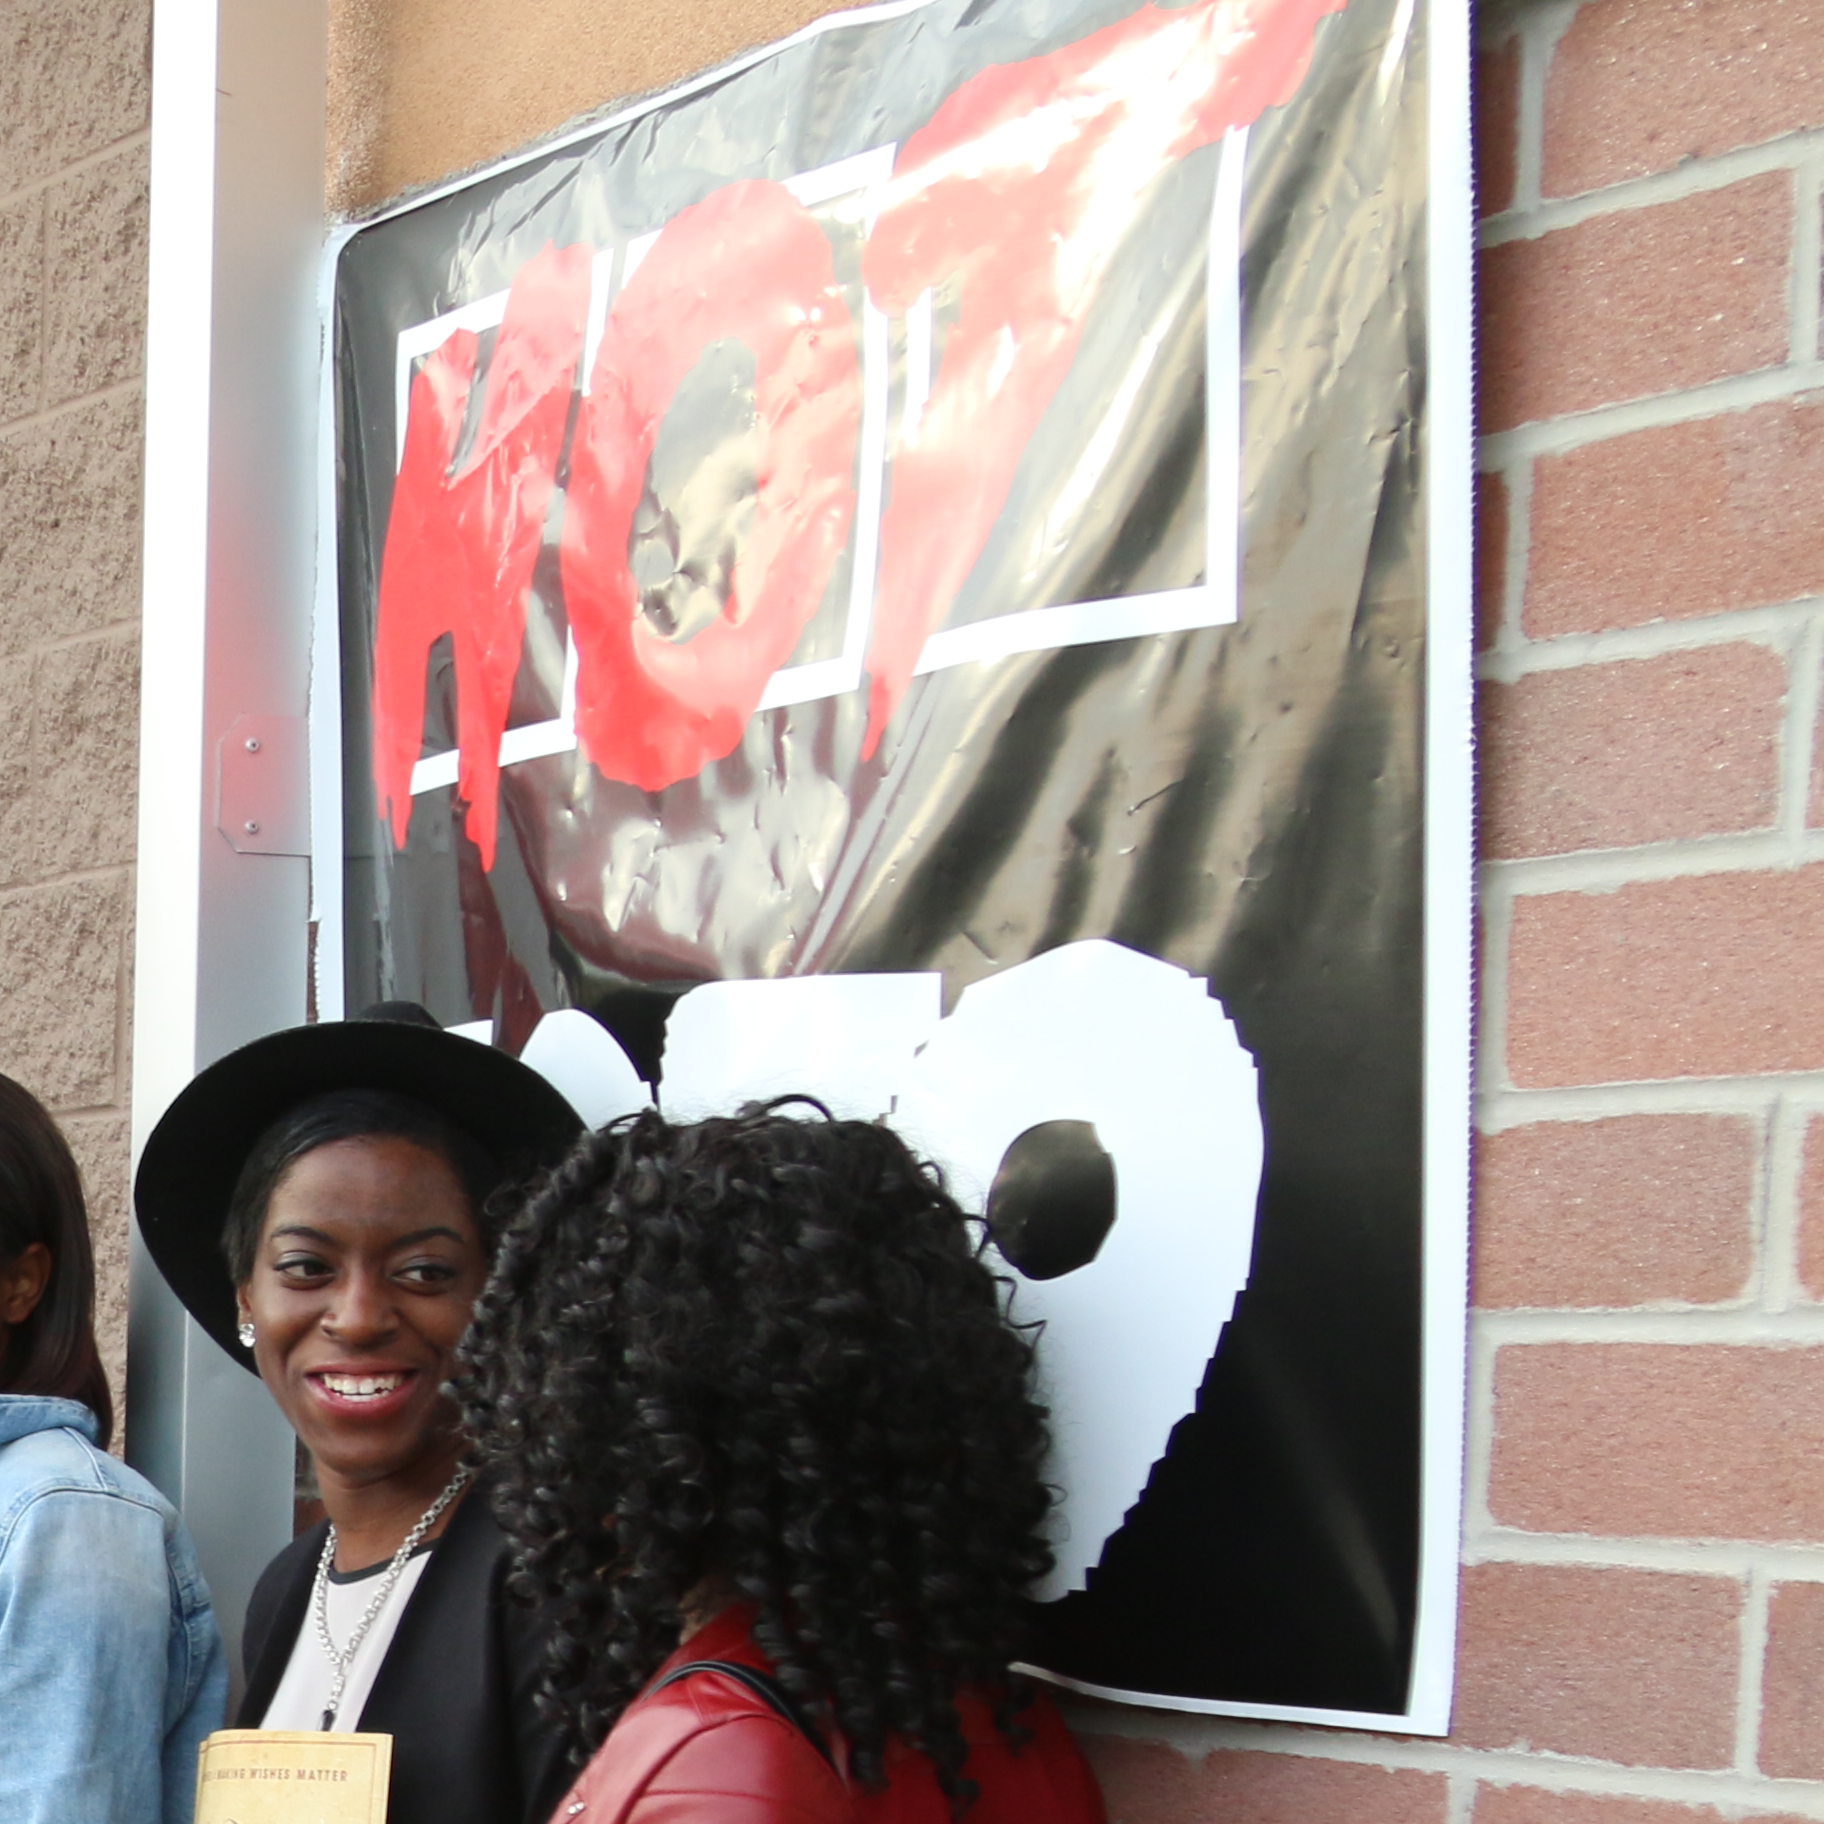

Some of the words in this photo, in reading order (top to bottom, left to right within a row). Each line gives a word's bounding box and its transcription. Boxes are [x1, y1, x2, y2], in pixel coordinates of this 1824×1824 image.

[376, 0, 1348, 872] HOT
[248, 1767, 292, 1781] WISHES
[295, 1768, 349, 1783] MATTER
